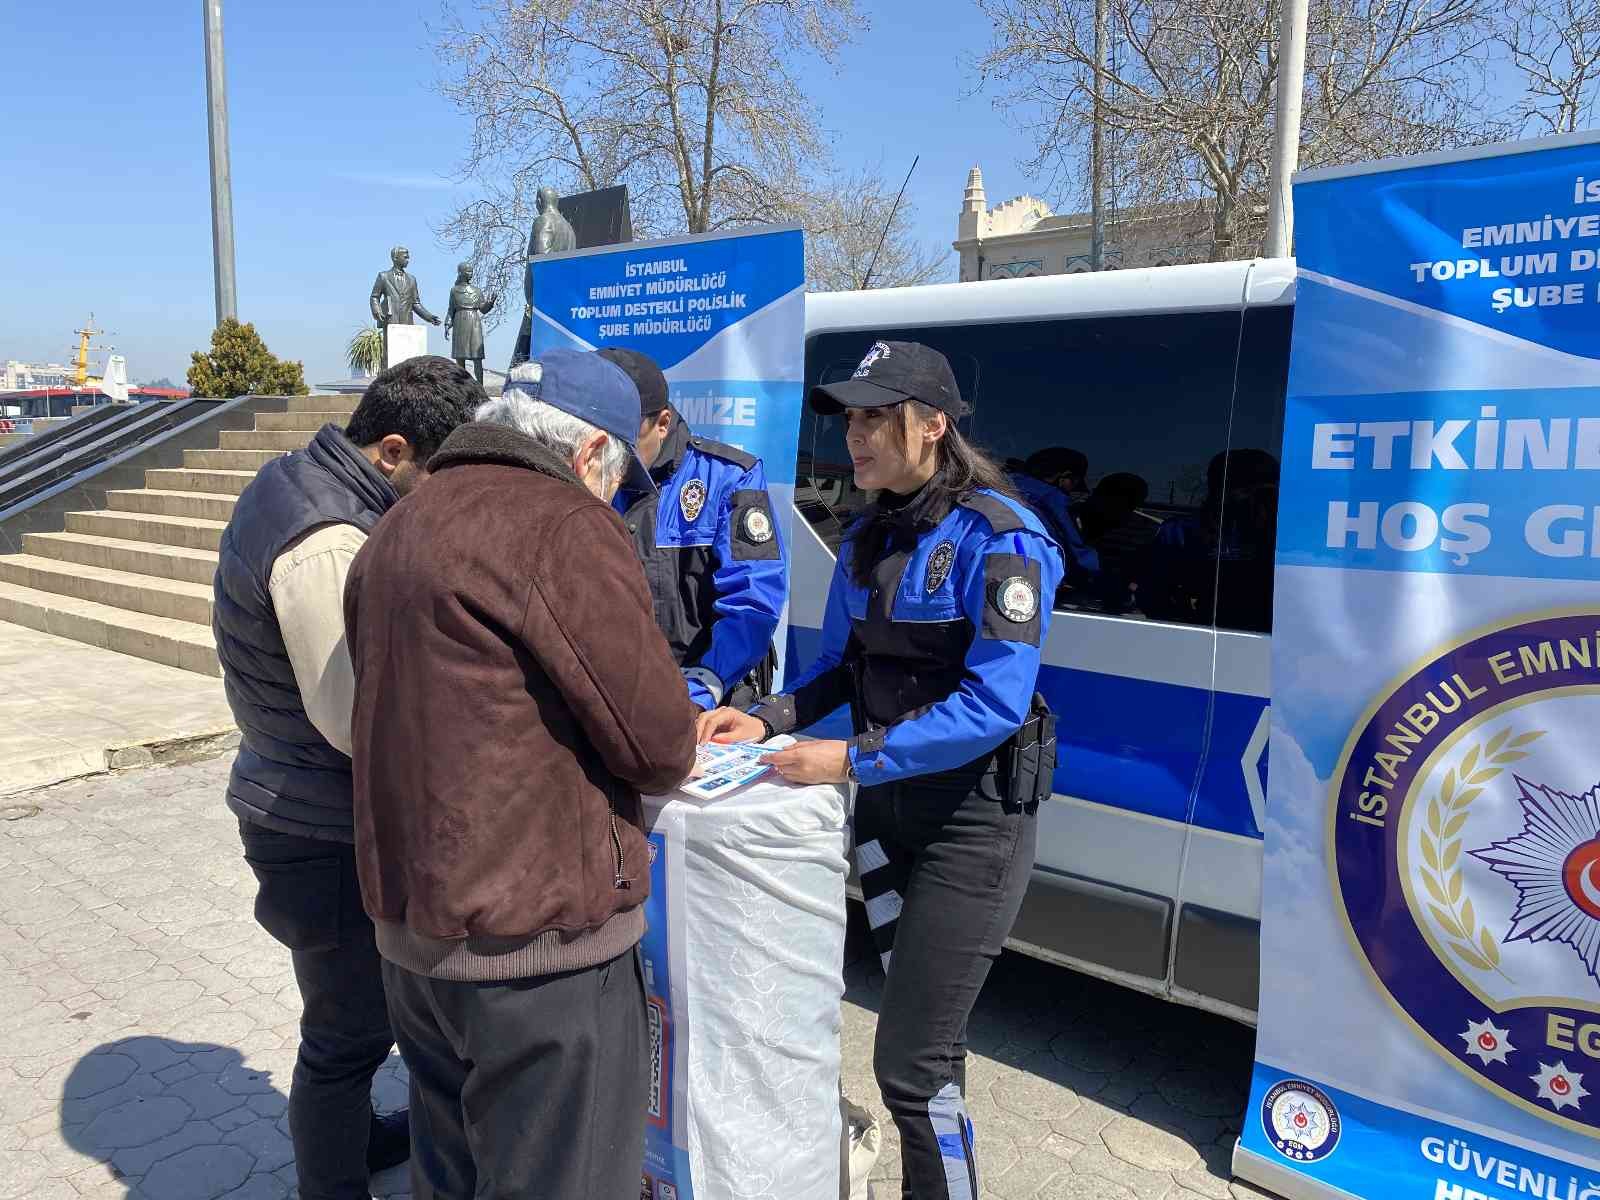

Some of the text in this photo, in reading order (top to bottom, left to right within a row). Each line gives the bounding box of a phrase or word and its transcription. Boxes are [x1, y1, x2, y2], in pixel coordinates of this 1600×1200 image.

[625, 259, 688, 278] İSTANBUL
[1410, 252, 1557, 283] TOPLUM
[589, 271, 727, 300] EMNİYET MÜDÜRLÜĞÜ
[1491, 283, 1584, 314] ŞUBE
[570, 291, 747, 320] TOPLUM DESTEKLİ POLİSLİK
[598, 318, 713, 339] ŞUBE MÜDÜRLÜĞÜ
[1326, 501, 1600, 567] HOŞ G
[1350, 673, 1488, 828] İSTANBUL
